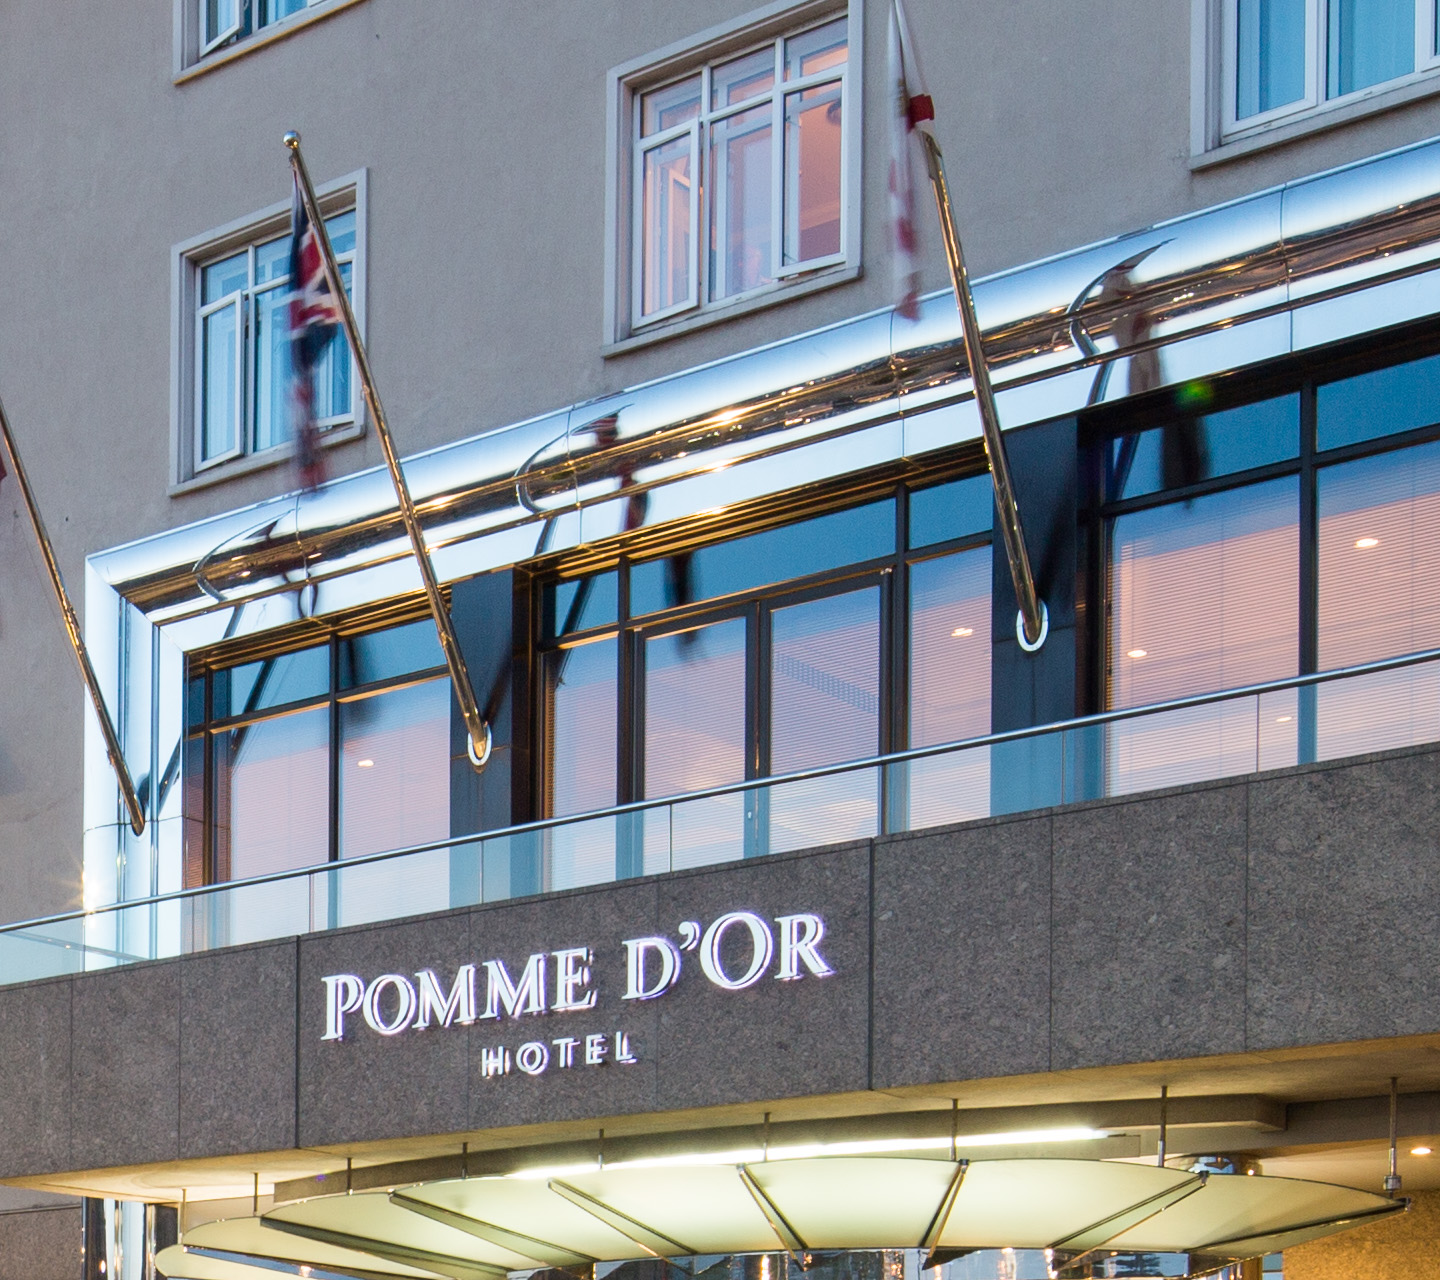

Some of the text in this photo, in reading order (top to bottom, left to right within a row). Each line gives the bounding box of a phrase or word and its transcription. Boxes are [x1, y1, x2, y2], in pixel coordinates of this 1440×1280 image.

[320, 911, 835, 1042] POMME D'OR
[481, 1031, 637, 1079] HOTEL
